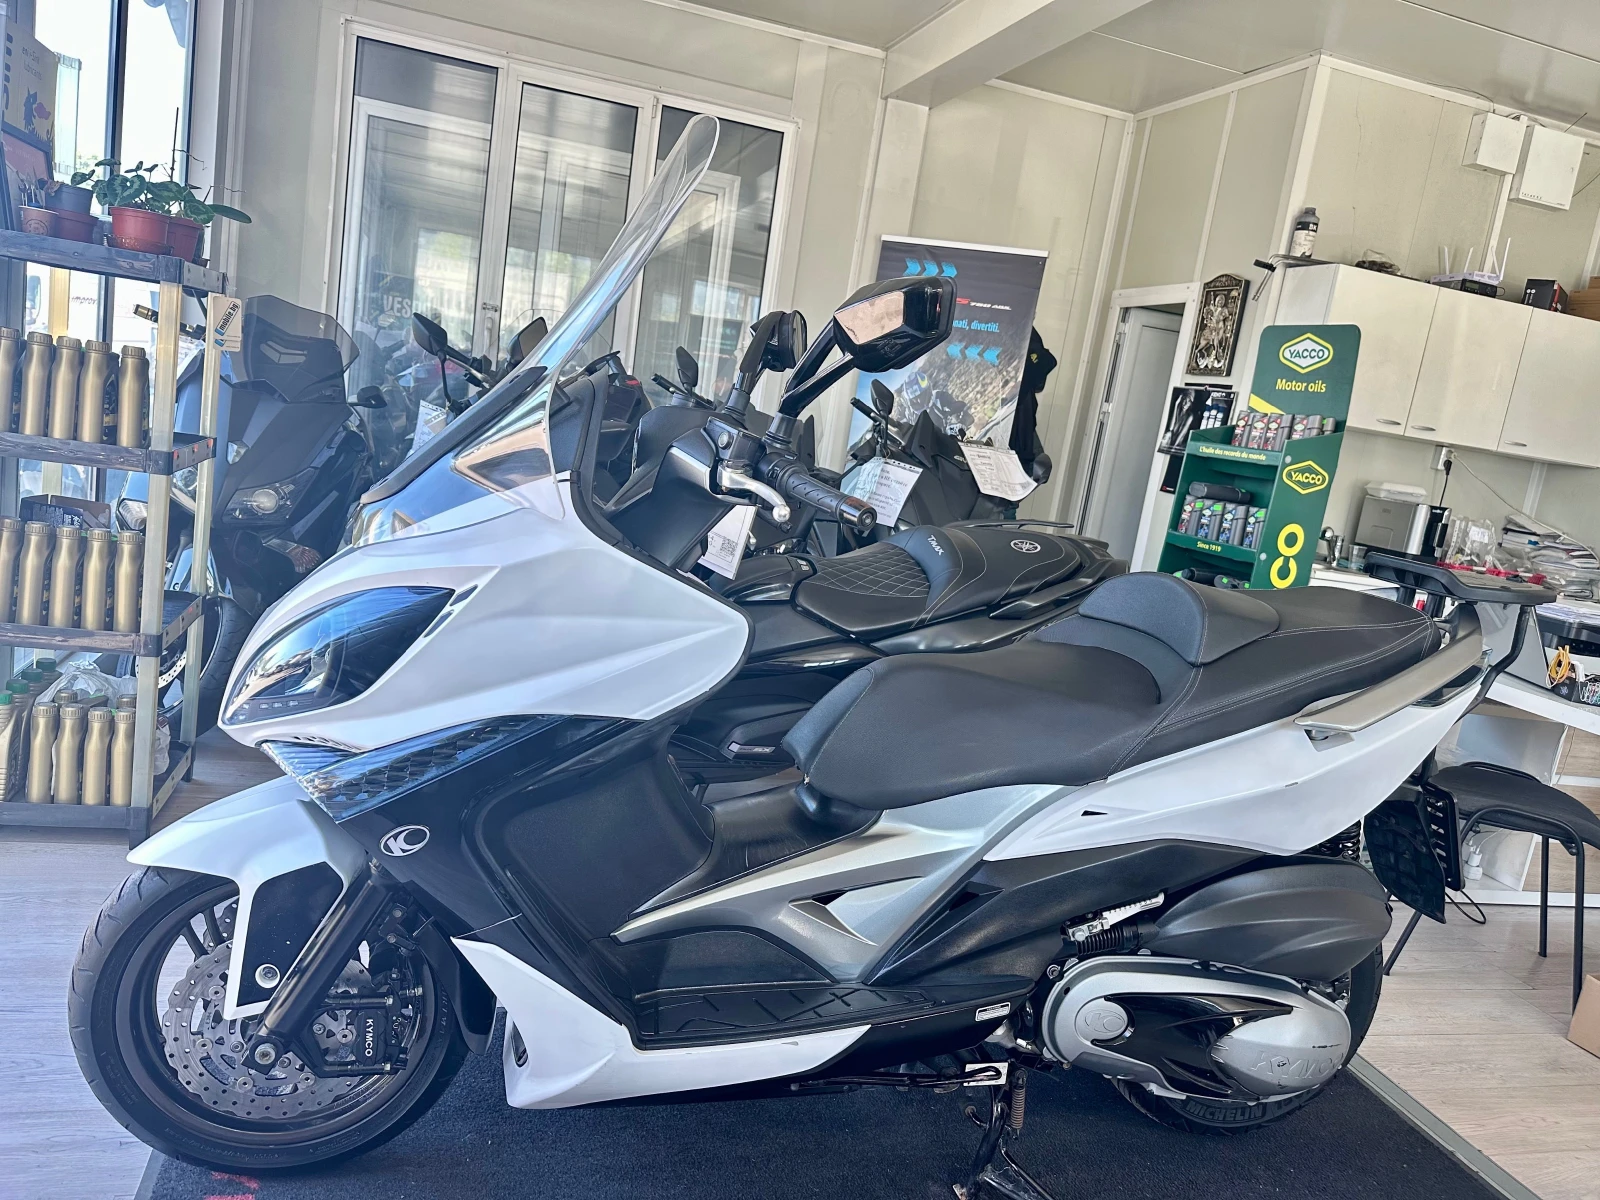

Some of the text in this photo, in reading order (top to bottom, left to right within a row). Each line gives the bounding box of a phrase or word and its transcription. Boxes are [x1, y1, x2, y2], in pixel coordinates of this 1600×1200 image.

[219, 303, 239, 331] mobile.bg
[971, 320, 1000, 333] divertiti.
[1288, 348, 1325, 359] YACCO
[1276, 378, 1326, 393] Motor oils
[1291, 471, 1323, 485] YACCO
[1196, 541, 1222, 552] Since 1919
[365, 1018, 374, 1057] KYMCO
[1185, 1101, 1263, 1121] MICHELIN
